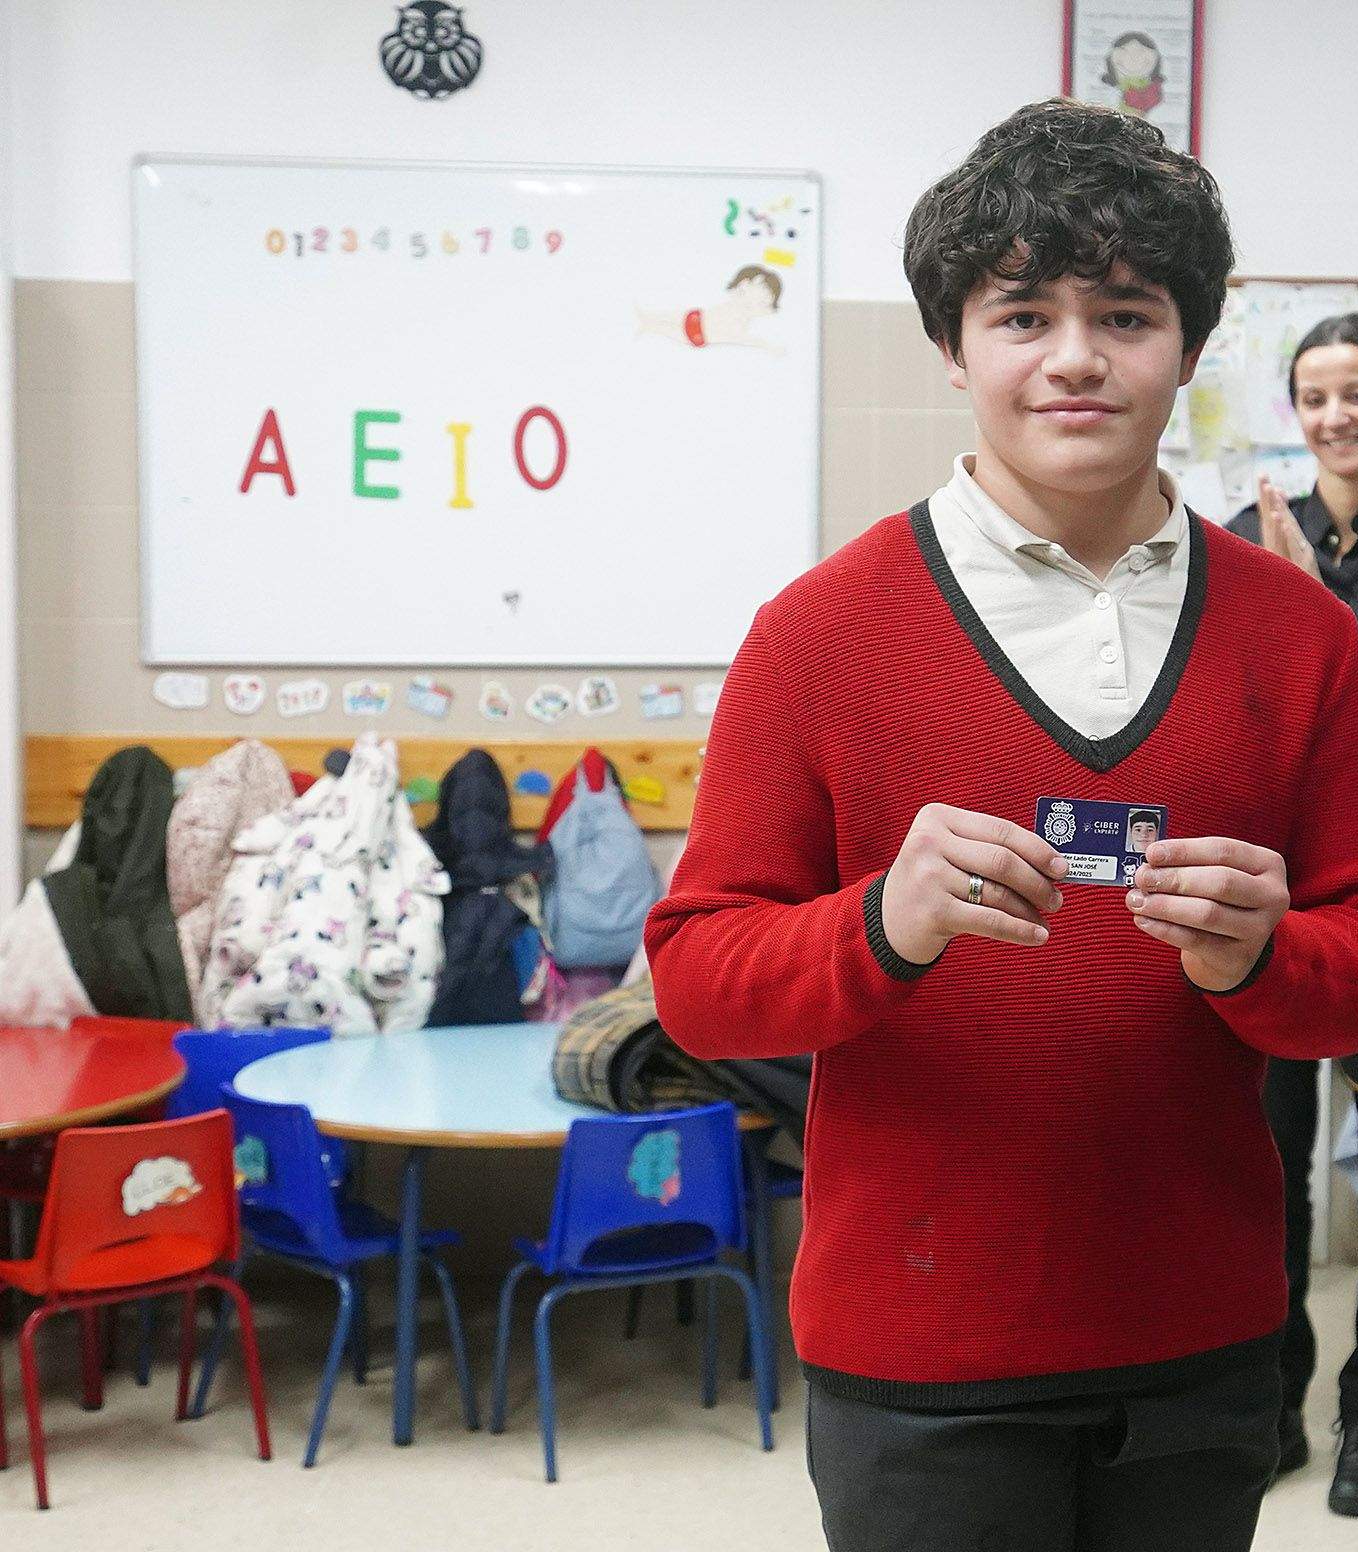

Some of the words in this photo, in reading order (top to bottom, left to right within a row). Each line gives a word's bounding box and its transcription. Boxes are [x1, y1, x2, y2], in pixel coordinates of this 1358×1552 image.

[239, 408, 296, 497] A
[353, 410, 400, 500] E
[447, 423, 474, 509] I
[513, 405, 568, 491] O
[1094, 821, 1120, 830] CIBER
